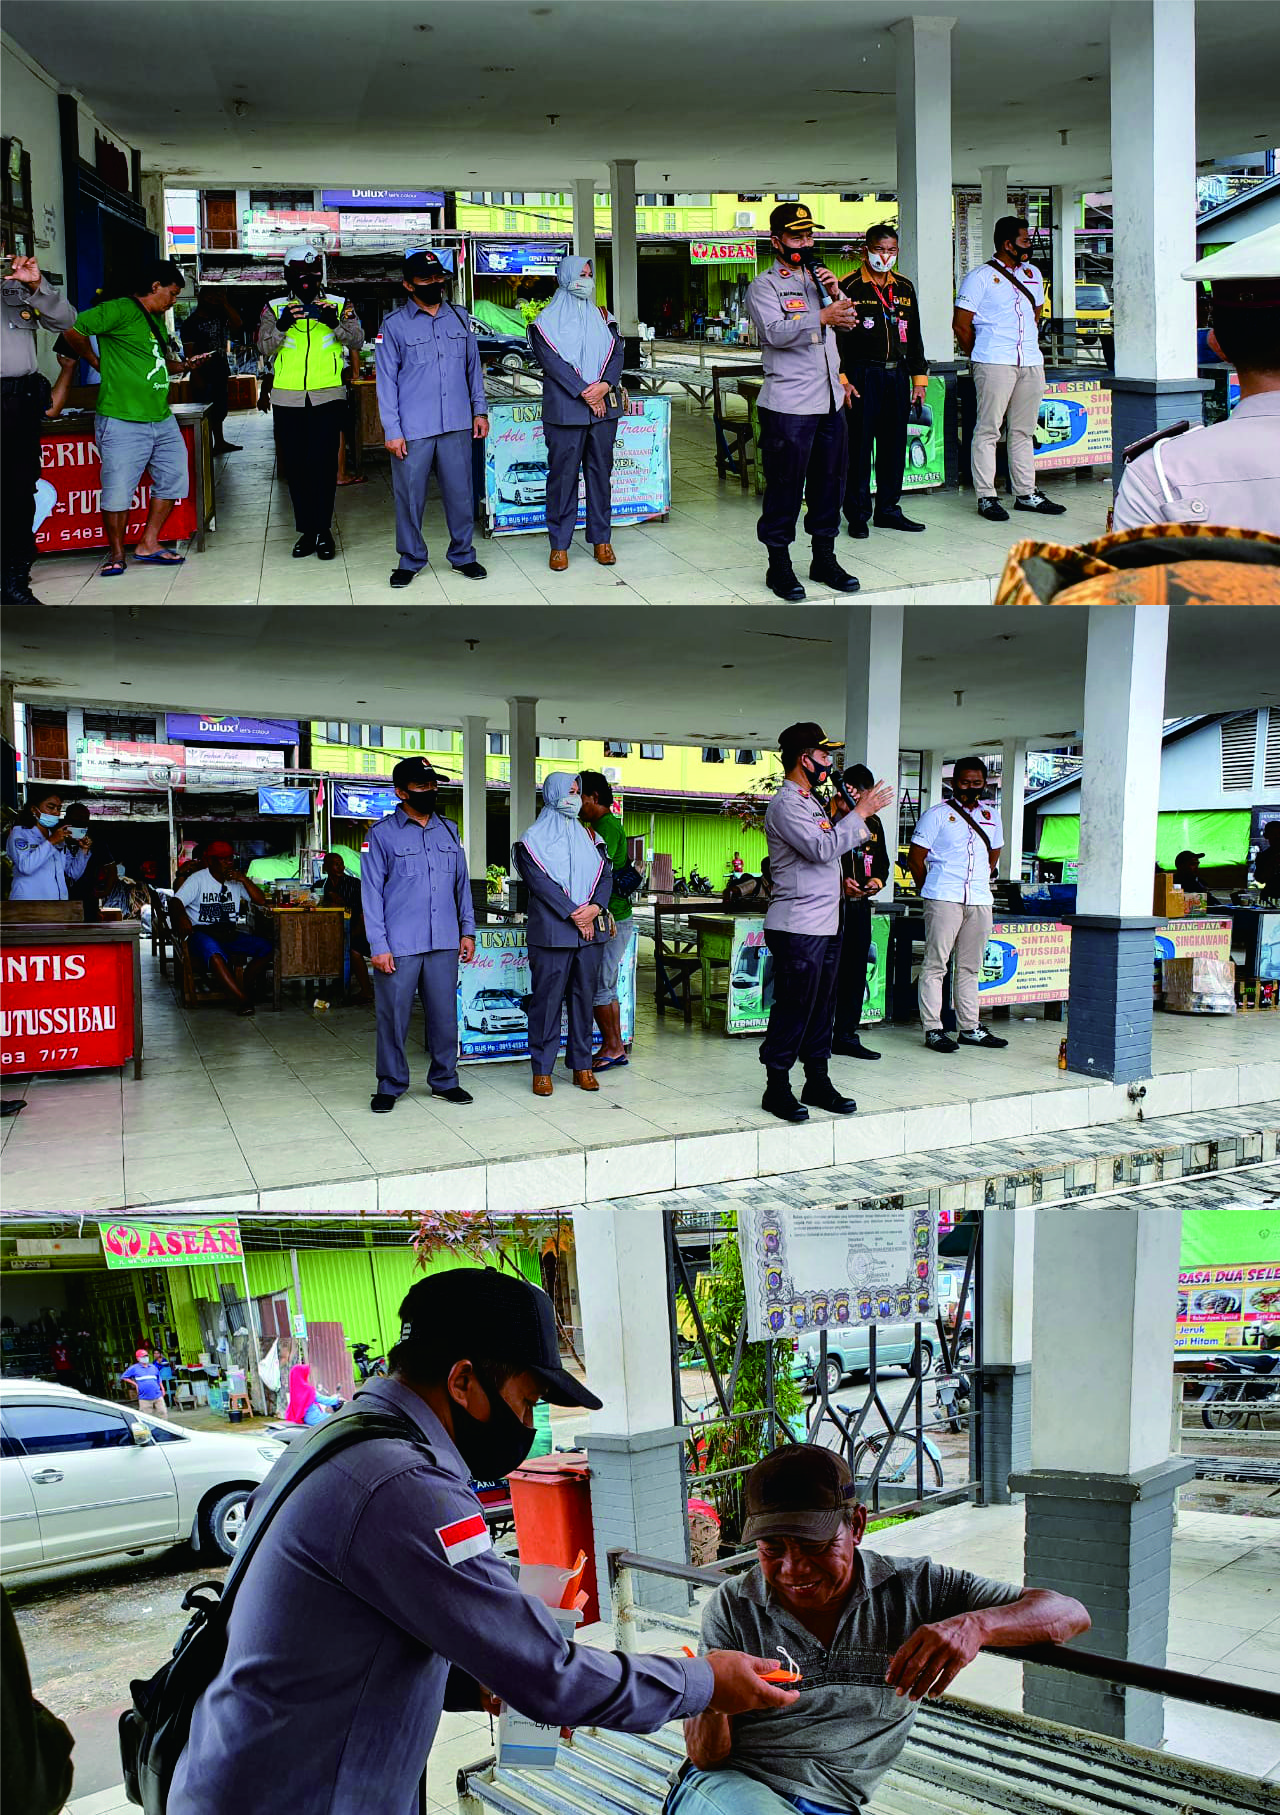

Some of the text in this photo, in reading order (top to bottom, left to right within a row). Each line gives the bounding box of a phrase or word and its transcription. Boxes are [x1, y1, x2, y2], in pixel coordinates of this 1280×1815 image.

[711, 245, 755, 260] ASEAN
[199, 722, 234, 733] Dulux
[1002, 923, 1057, 934] SENTOSA
[1021, 934, 1064, 945] SINTANG
[1175, 934, 1229, 948] SINGKAWANG
[38, 1047, 79, 1062] 7177
[147, 1229, 238, 1256] ASEAN
[1178, 1271, 1211, 1284] RASA
[1214, 1269, 1243, 1283] DUA
[1180, 1325, 1205, 1335] Jeruk
[1190, 1337, 1219, 1346] Hitam
